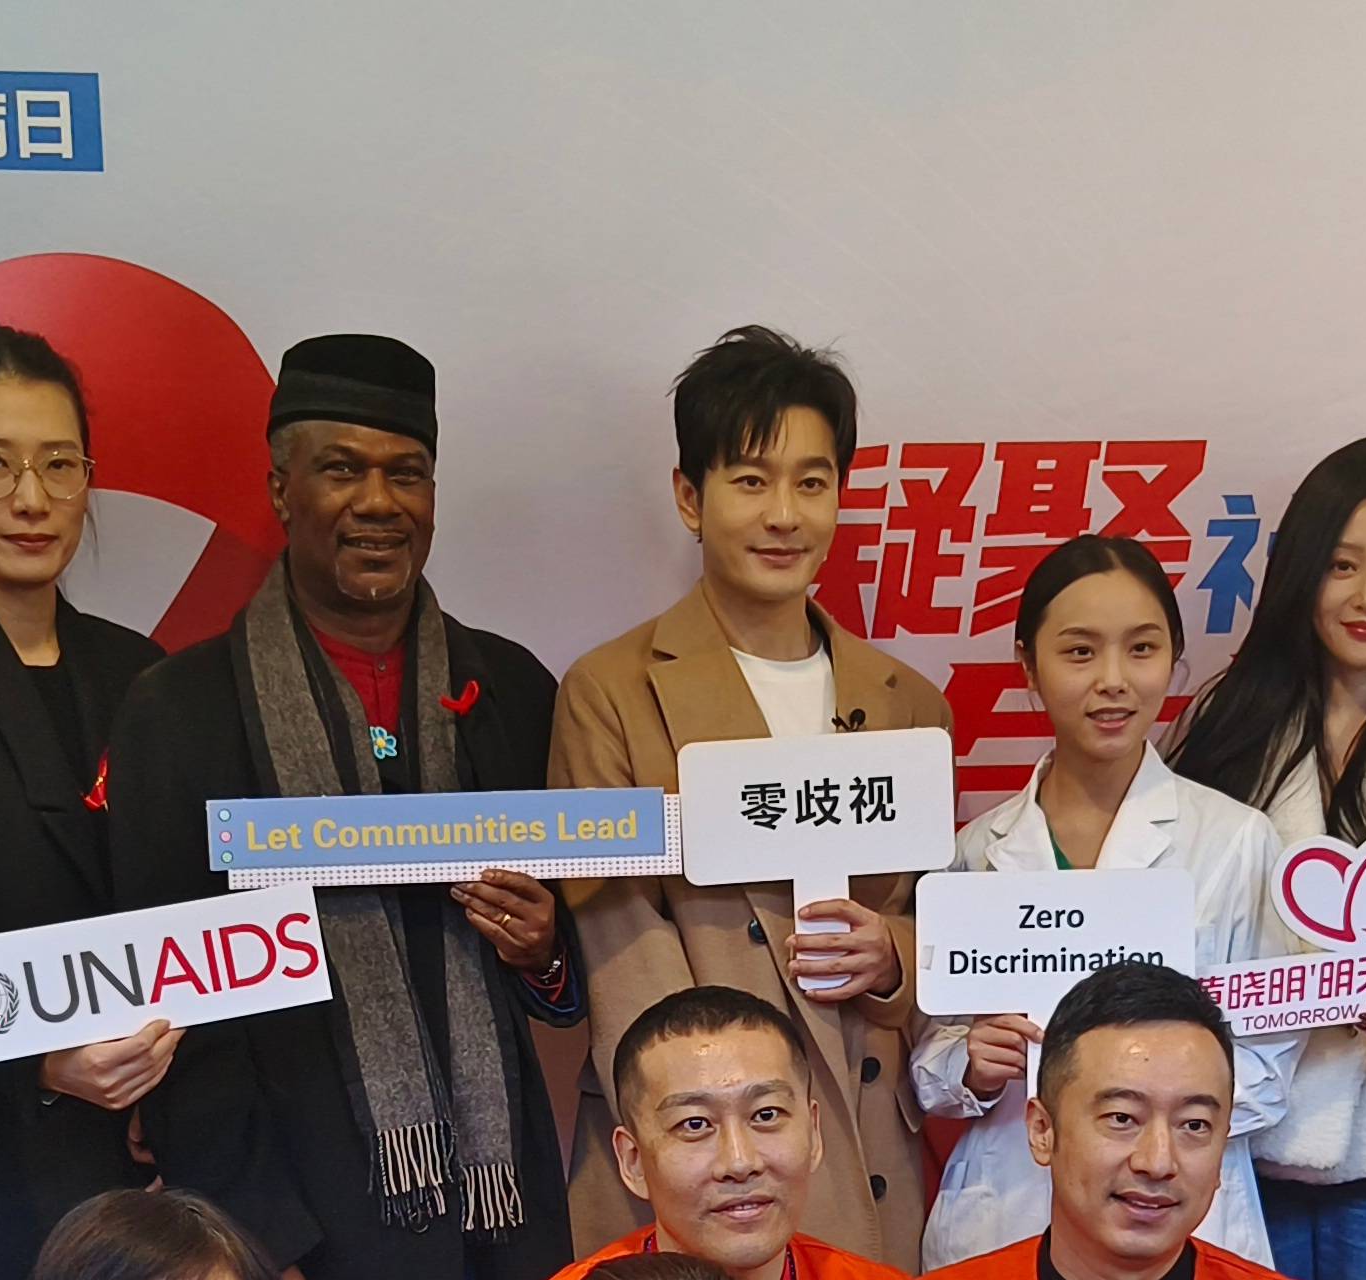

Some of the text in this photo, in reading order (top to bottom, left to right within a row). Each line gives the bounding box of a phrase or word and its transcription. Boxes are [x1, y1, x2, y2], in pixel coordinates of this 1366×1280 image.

[740, 776, 897, 830] 零歧视
[246, 809, 637, 852] Let Communities Lead
[1019, 904, 1085, 931] Zero
[23, 912, 321, 1023] UNAIDS
[948, 946, 1164, 976] Discrimination
[1242, 1003, 1359, 1032] TOMORROW
